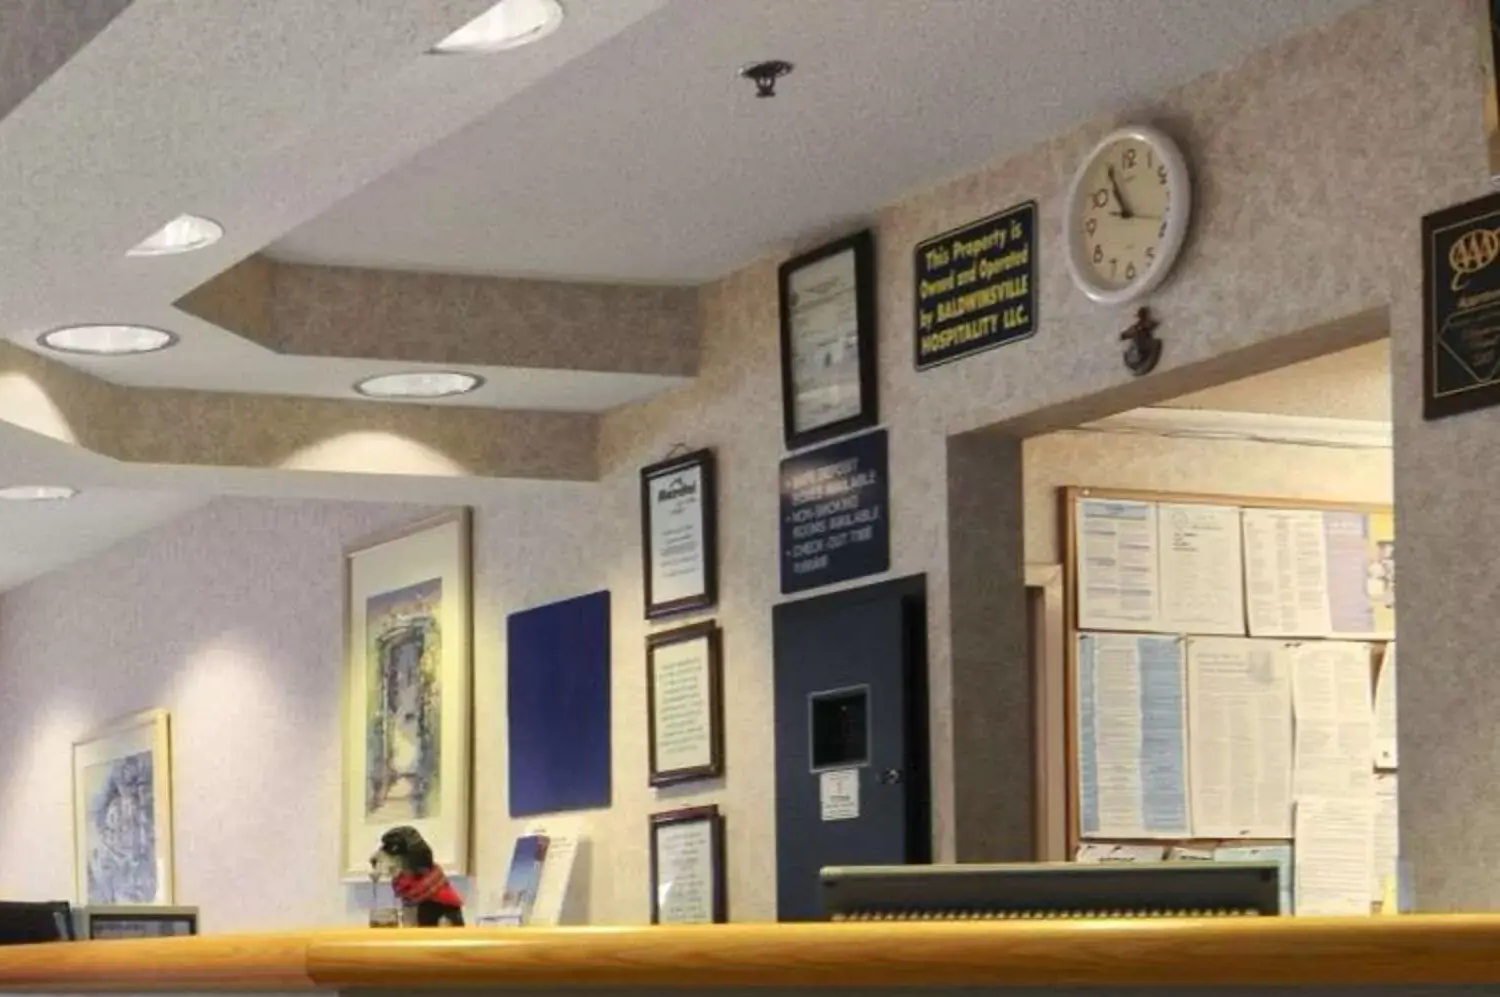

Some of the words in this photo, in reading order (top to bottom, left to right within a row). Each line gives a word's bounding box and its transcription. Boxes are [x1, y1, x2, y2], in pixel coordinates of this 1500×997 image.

[1122, 148, 1138, 170] 12
[1085, 217, 1098, 239] 9
[926, 246, 949, 272] This
[952, 229, 1007, 261] Property
[1011, 219, 1023, 241] is
[1093, 244, 1103, 265] 8
[1451, 229, 1497, 271] AAA
[920, 270, 955, 299] Owned
[957, 264, 977, 286] and
[979, 242, 1029, 281] Operated
[1108, 257, 1118, 278] 7
[1125, 260, 1137, 281] 6
[920, 309, 934, 332] by
[937, 274, 1029, 322] BALDWINSVILLE
[921, 314, 1000, 356] HOSPITALITY
